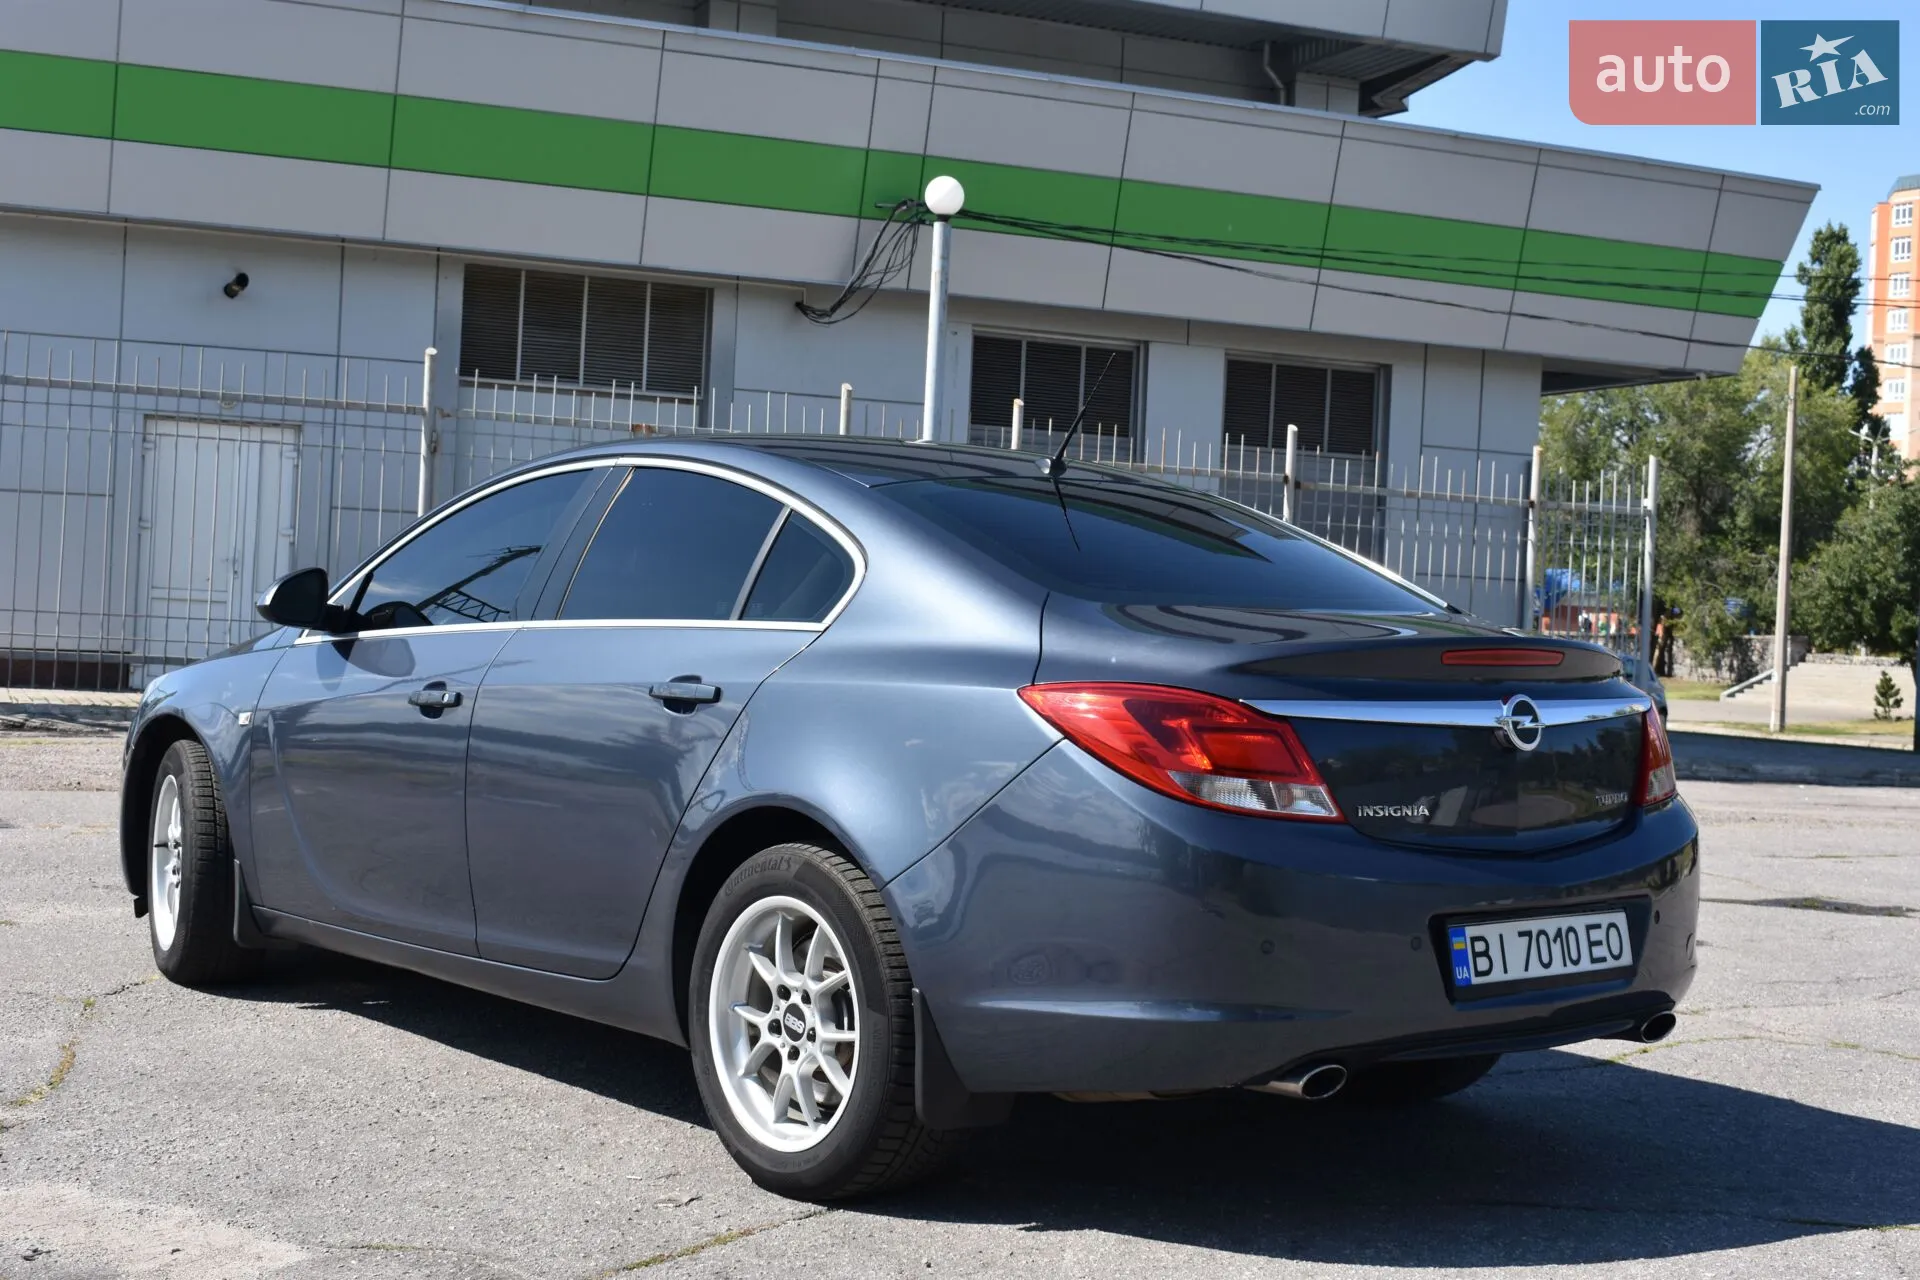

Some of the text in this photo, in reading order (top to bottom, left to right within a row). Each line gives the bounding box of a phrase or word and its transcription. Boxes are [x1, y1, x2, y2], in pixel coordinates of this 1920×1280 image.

[1357, 805, 1430, 817] INSIGNIA
[1470, 921, 1624, 978] BI 7010 EO
[1455, 965, 1470, 980] UA
[784, 1012, 805, 1034] BBS
